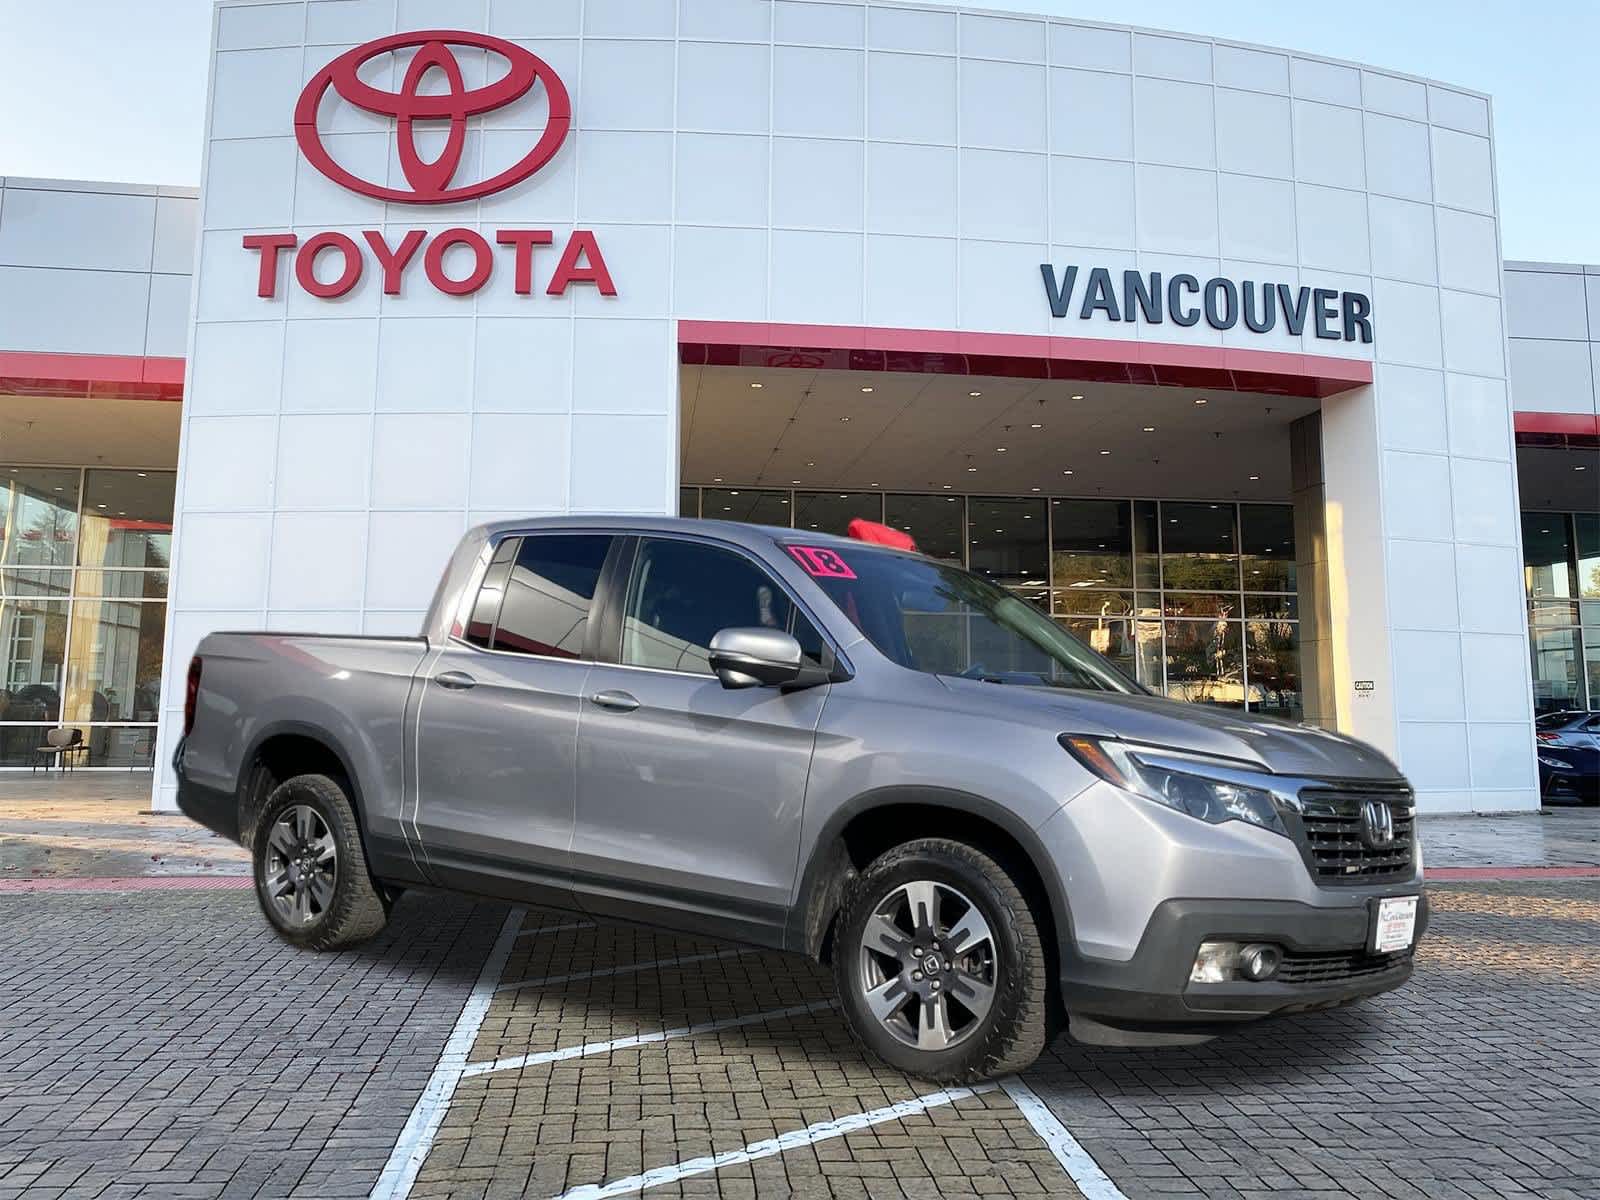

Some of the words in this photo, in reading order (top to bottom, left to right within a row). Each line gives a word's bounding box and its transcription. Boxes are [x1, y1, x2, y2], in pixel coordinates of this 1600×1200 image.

[243, 228, 618, 298] TOYOTA
[1040, 264, 1373, 343] VANCOUVER
[793, 549, 846, 573] 18
